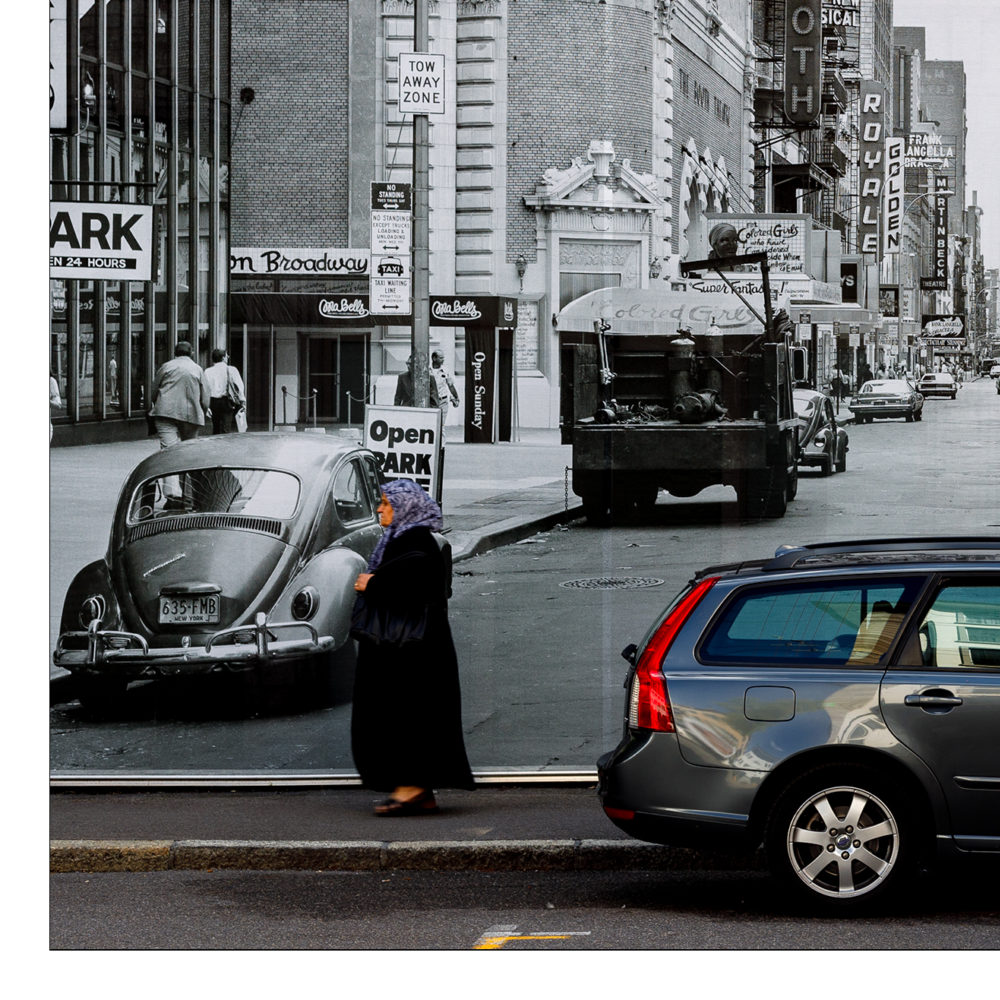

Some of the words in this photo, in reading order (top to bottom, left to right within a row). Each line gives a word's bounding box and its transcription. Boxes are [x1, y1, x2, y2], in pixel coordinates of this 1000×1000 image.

[409, 61, 435, 72] TOW
[403, 76, 440, 88] AWAY
[403, 91, 440, 104] ZONE
[909, 134, 942, 146] FRANK
[862, 93, 882, 253] ROYALE
[888, 143, 901, 249] GOLDEN
[50, 211, 144, 251] ARK
[738, 226, 773, 244] Colored
[66, 257, 82, 267] 24
[87, 258, 127, 269] HOURS
[231, 255, 257, 272] on
[260, 250, 368, 274] Broadway
[381, 265, 400, 273] TAXI
[936, 240, 945, 278] BECK
[471, 352, 486, 381] Open
[471, 385, 486, 430] Sunday
[369, 420, 434, 449] Open
[163, 598, 216, 615] 635-FMB
